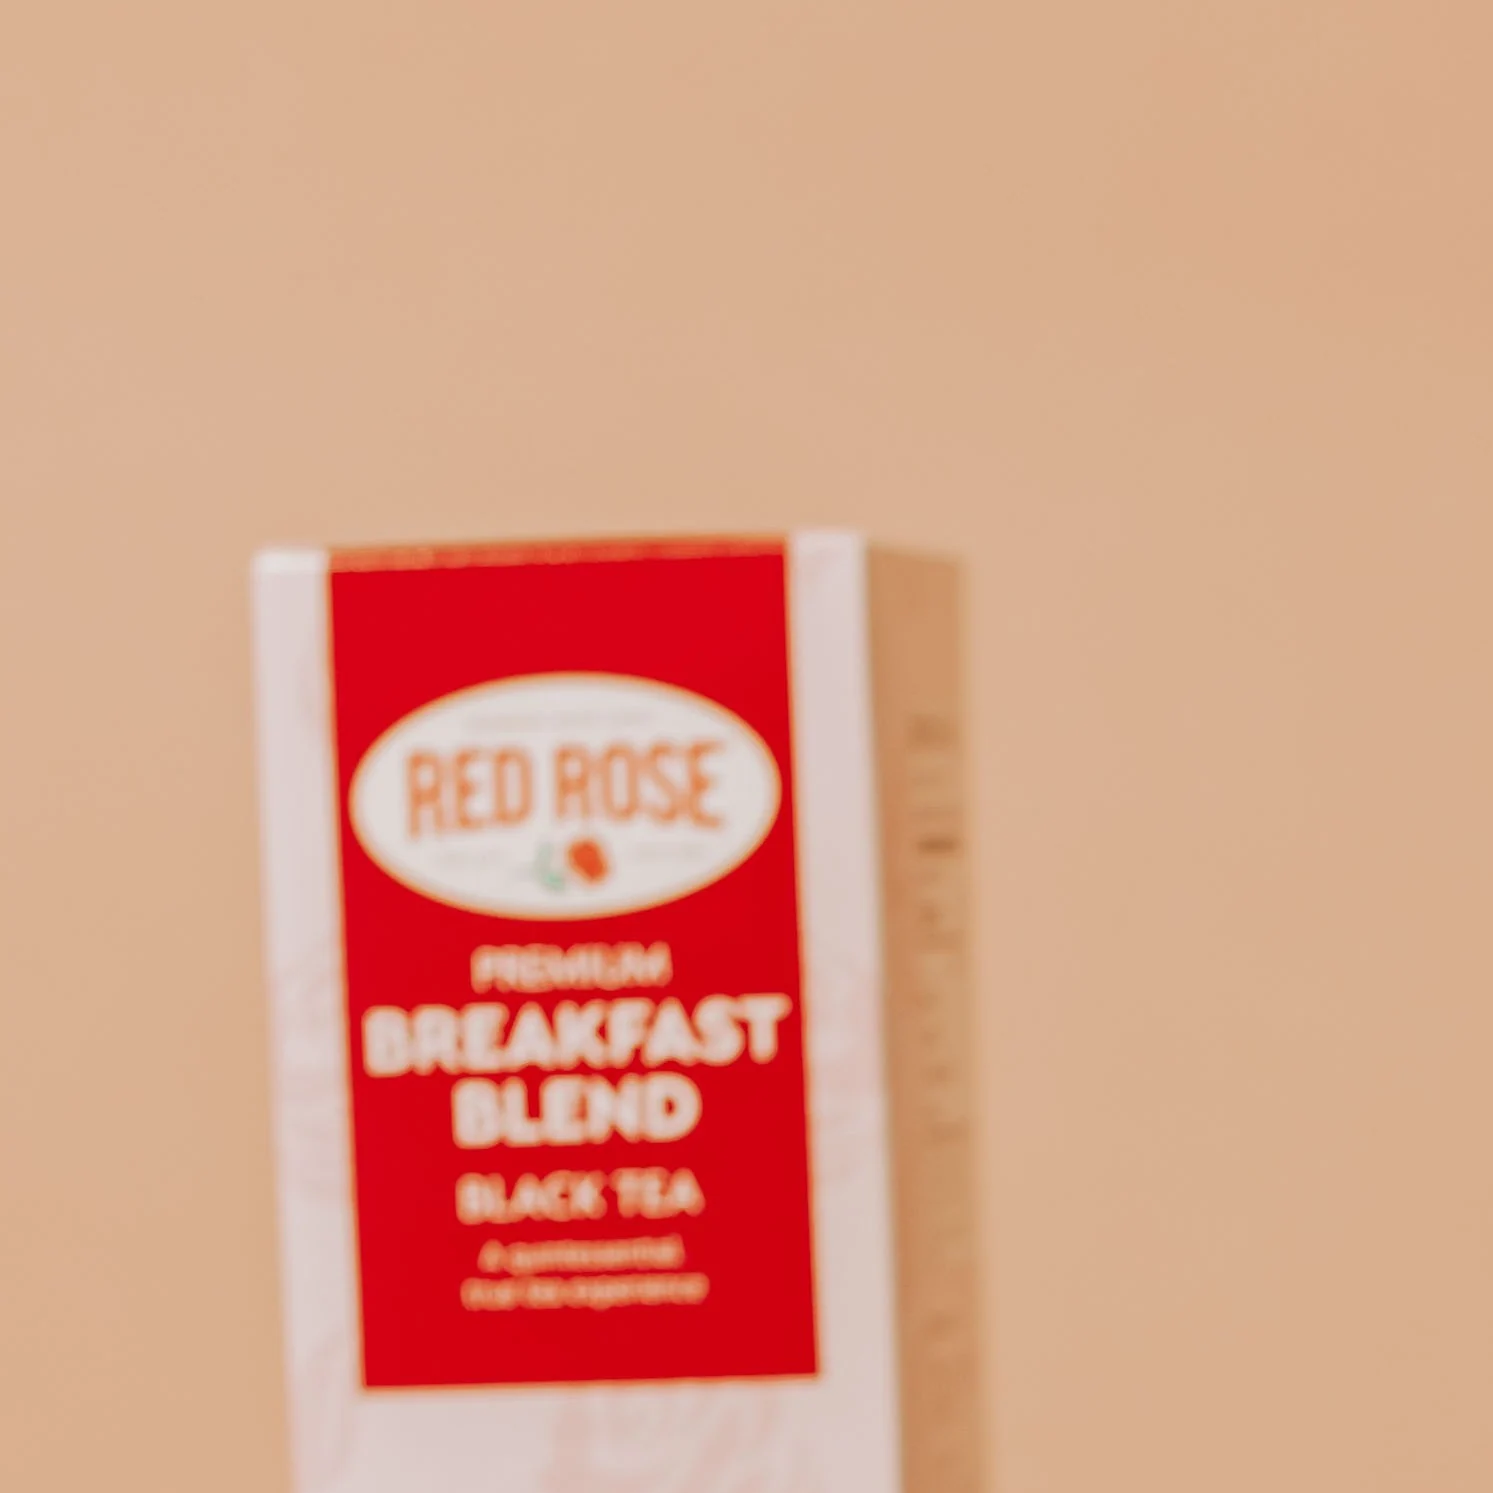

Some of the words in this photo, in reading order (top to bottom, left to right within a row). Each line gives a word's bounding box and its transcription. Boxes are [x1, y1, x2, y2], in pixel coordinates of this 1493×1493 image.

[406, 746, 533, 841] RED
[555, 740, 724, 831] ROSE
[471, 941, 673, 993] PREMIUM
[361, 993, 793, 1077] BREAKFAST
[450, 1071, 702, 1148] BLEND
[455, 1170, 607, 1225] BLACK
[609, 1167, 706, 1219] TEA
